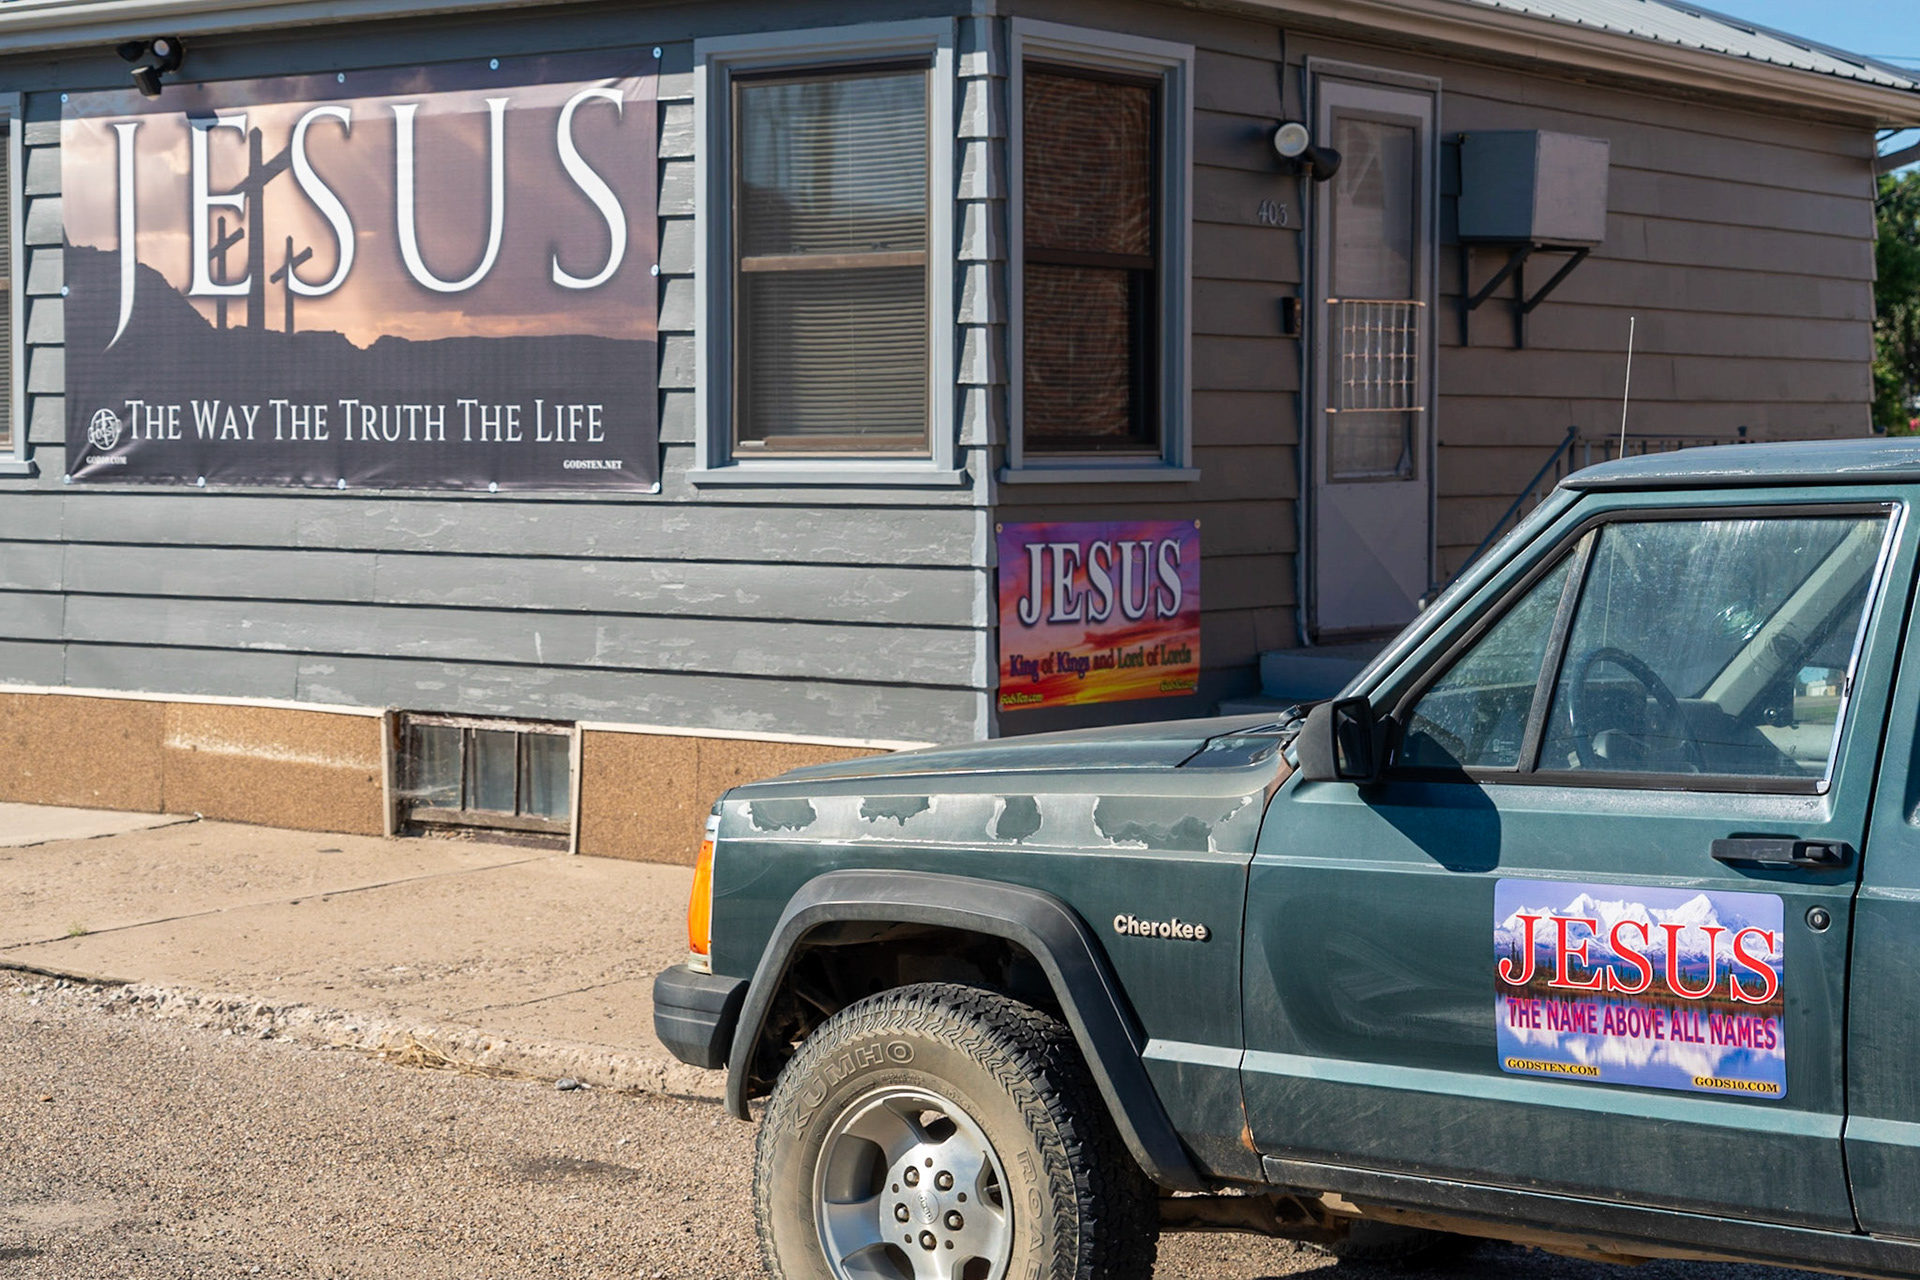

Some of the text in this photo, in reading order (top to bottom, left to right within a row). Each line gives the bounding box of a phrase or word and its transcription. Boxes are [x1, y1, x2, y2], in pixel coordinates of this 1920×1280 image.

[104, 87, 628, 351] JESUS
[1258, 199, 1287, 226] 403
[125, 400, 182, 441] THE
[191, 400, 260, 441] WAY
[269, 399, 330, 442] THE
[338, 399, 446, 442] TRUTH
[457, 398, 523, 442] THE
[535, 399, 605, 442] LIFE
[563, 459, 622, 469] GODSTEN.NET
[1018, 539, 1183, 626] JESUS
[1010, 643, 1192, 682] King of Kings and Lord of Lords
[1113, 914, 1208, 940] Cherokee
[1498, 914, 1778, 1005] JESUS
[1507, 998, 1777, 1050] THE NAME ABOVE ALL NAMES
[1507, 1058, 1598, 1076] GODSTEN.COM
[1694, 1076, 1779, 1093] GODS10.COM
[787, 1039, 915, 1141] KUMHO
